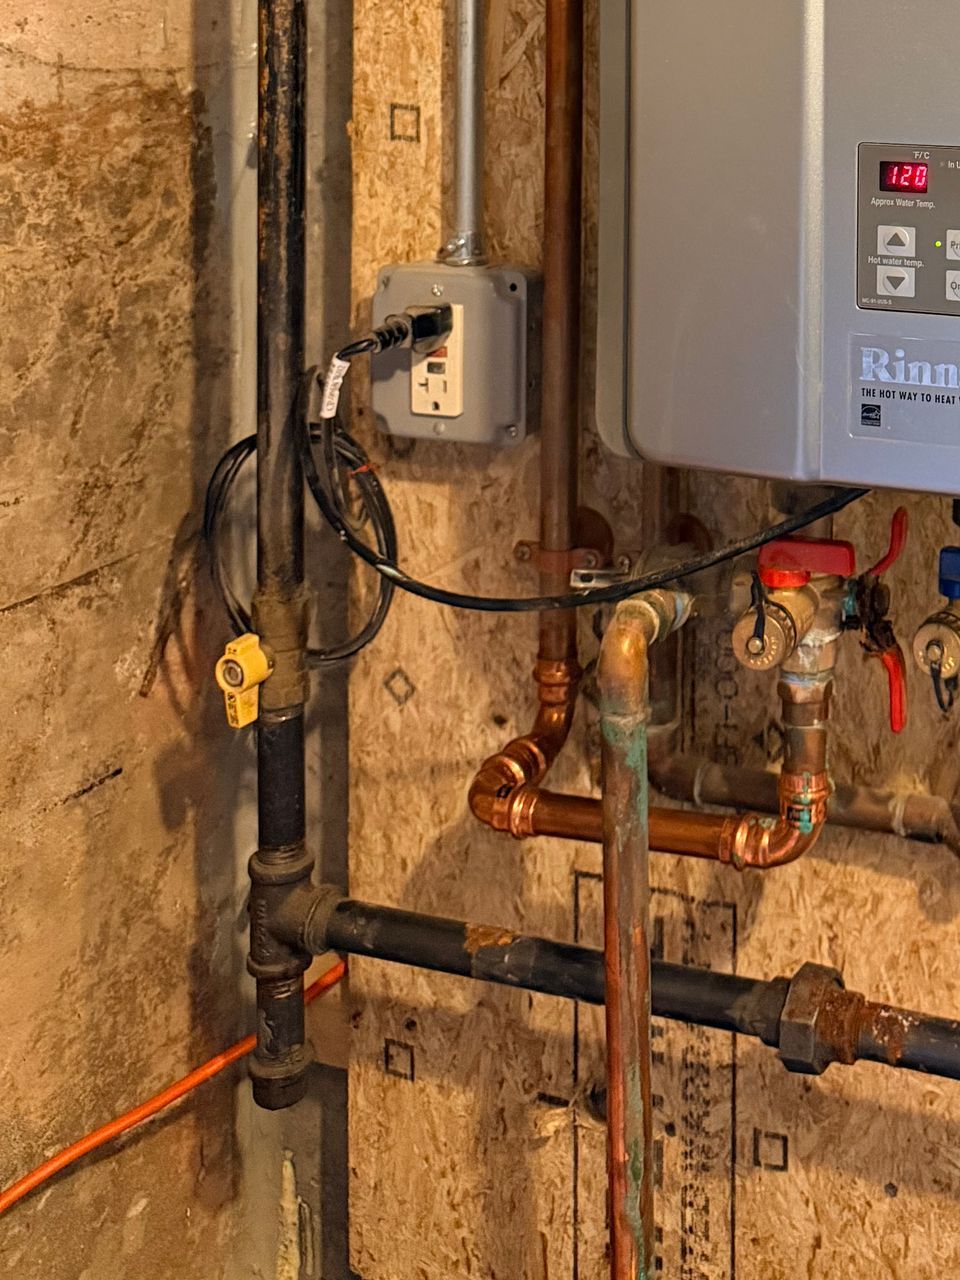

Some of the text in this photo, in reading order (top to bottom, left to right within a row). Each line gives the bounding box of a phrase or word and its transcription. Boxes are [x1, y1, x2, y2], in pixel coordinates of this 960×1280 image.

[948, 161, 955, 169] In
[892, 166, 928, 186] 120
[871, 197, 936, 209] Approx Water Temp.
[867, 256, 881, 264] Hot
[904, 259, 924, 268] temp.
[861, 388, 876, 398] THE
[879, 390, 896, 399] HOT
[899, 391, 918, 401] WAY
[921, 393, 931, 403] TO
[934, 394, 955, 405] HEAT
